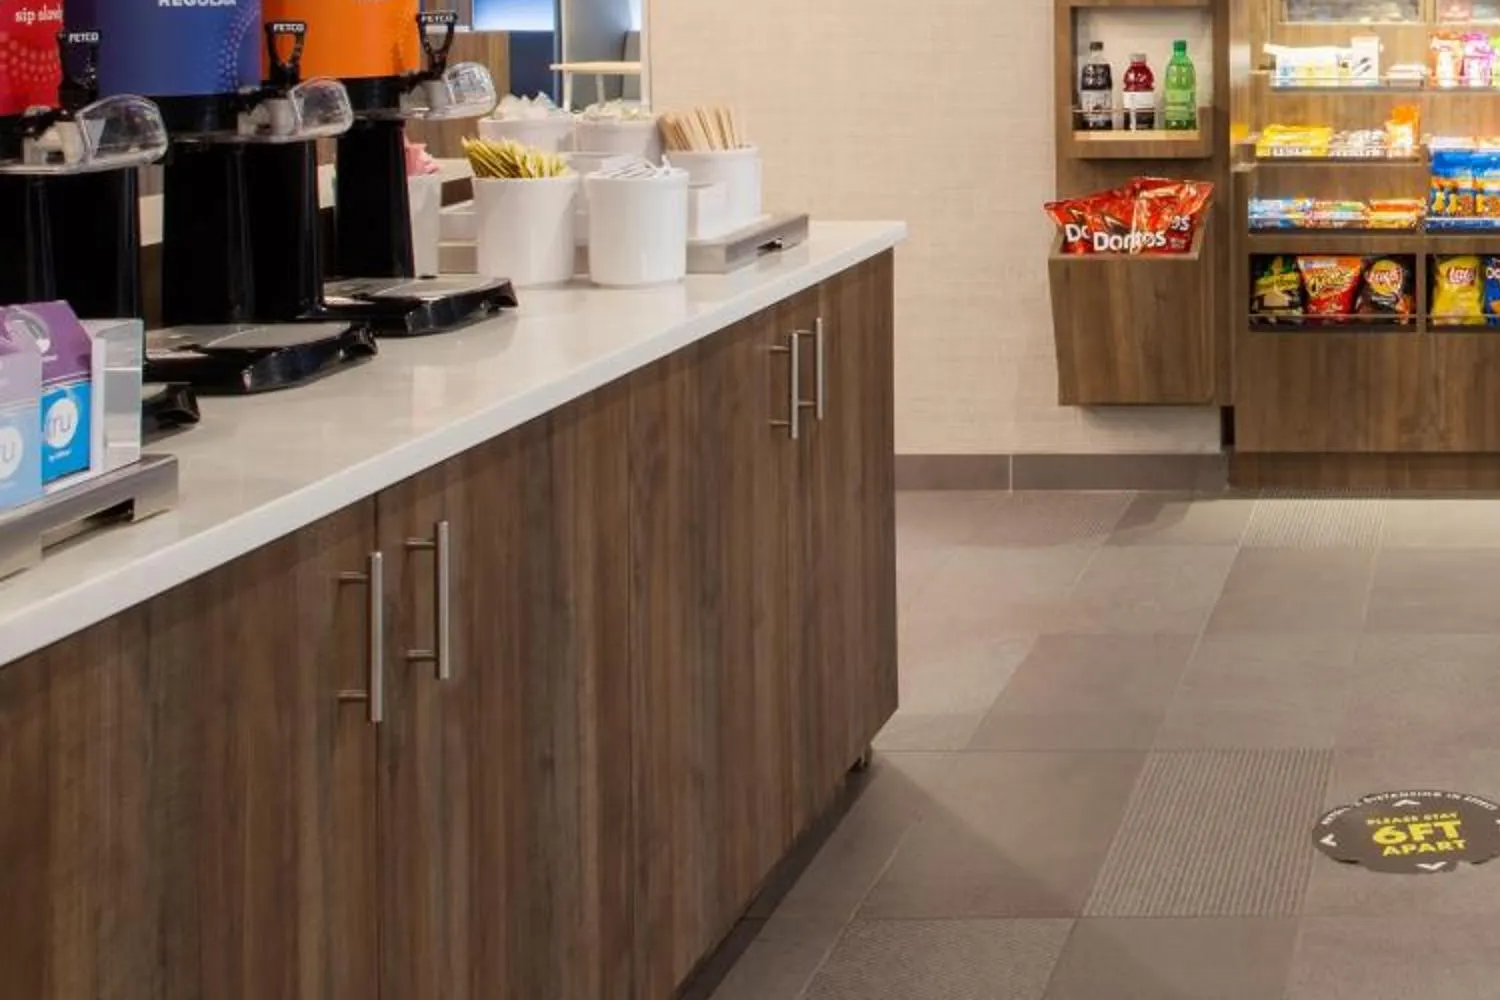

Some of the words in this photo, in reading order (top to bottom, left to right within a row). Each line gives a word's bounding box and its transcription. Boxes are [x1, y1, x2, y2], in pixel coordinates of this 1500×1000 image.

[15, 7, 36, 26] sip
[1093, 230, 1167, 254] Doritos
[1366, 815, 1419, 826] PLEASE
[1424, 812, 1459, 822] STAY
[1373, 820, 1461, 845] 6FT
[1382, 839, 1467, 857] APART
